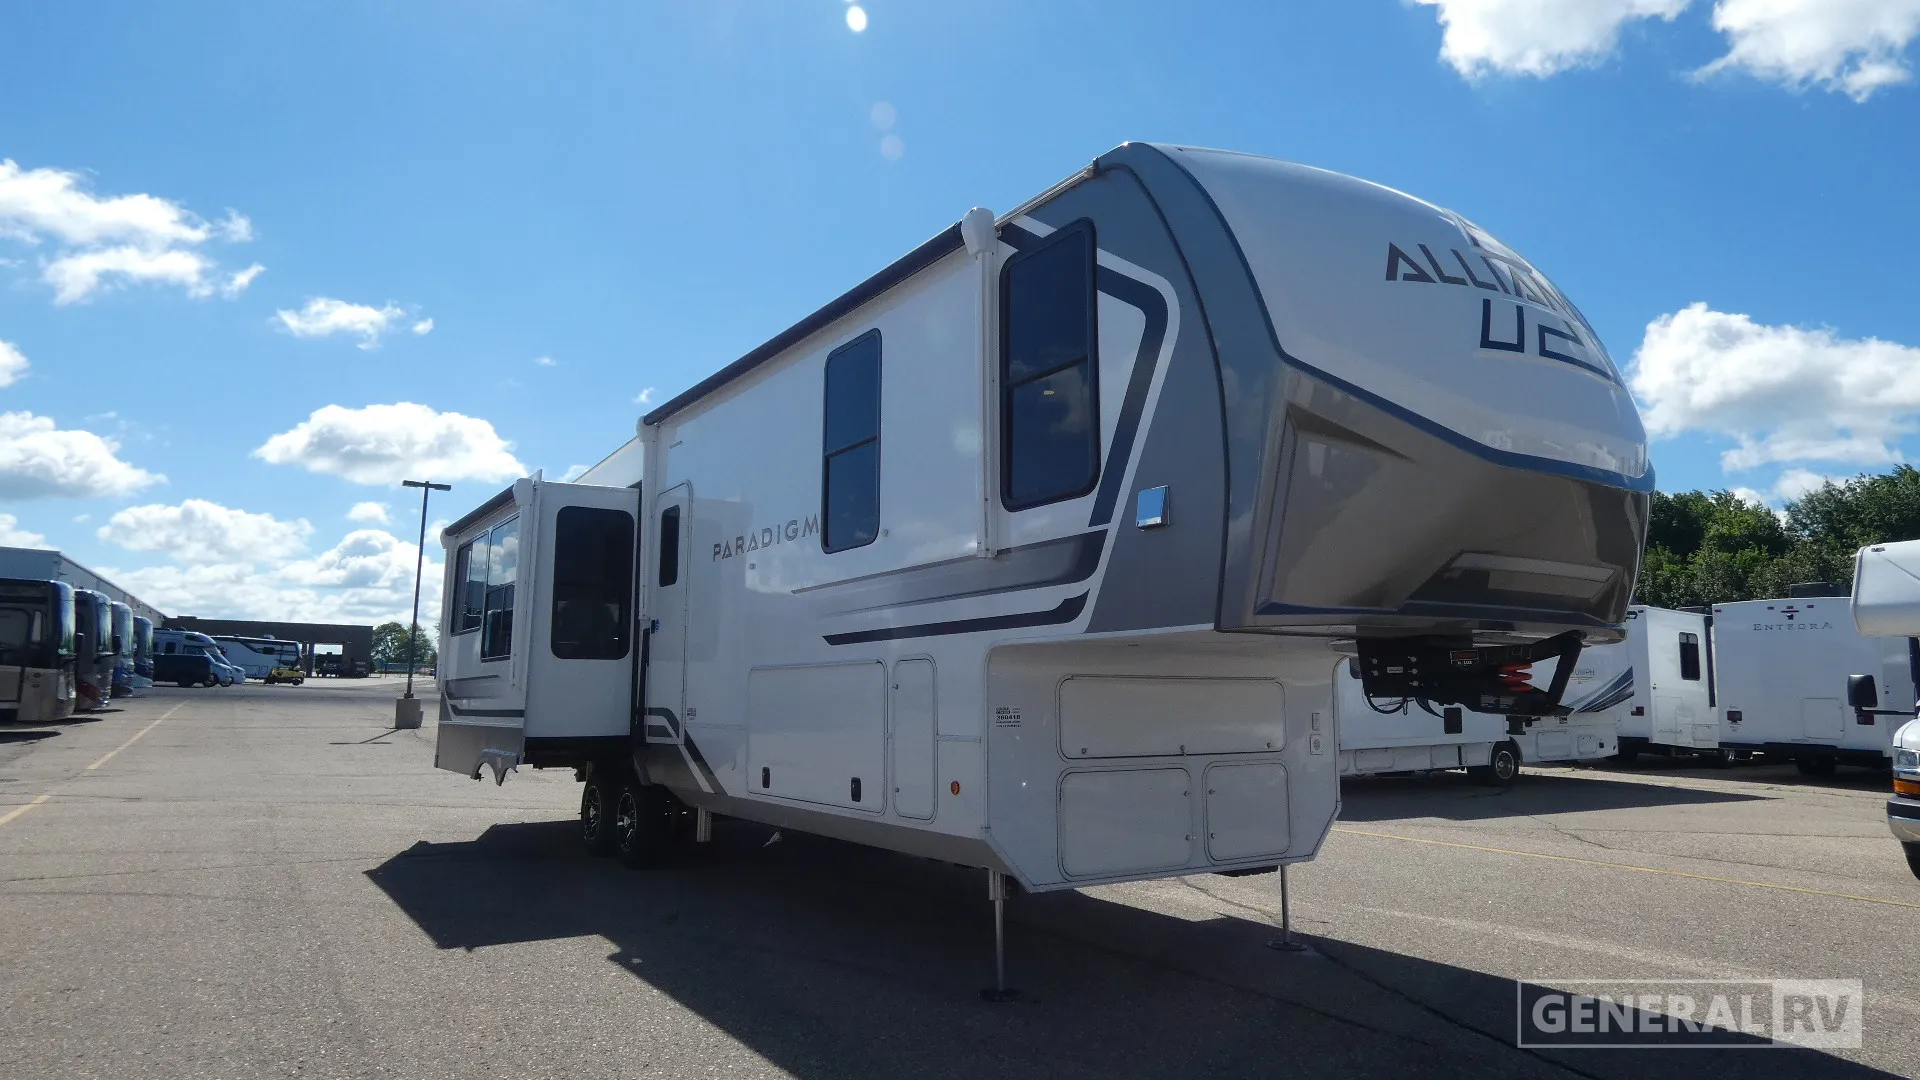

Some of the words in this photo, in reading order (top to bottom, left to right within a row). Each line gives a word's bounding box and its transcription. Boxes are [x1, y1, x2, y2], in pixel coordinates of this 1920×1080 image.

[1385, 241, 1582, 323] ALLIAN
[712, 513, 820, 562] PARADIGM
[1752, 621, 1833, 631] ENTEGRA
